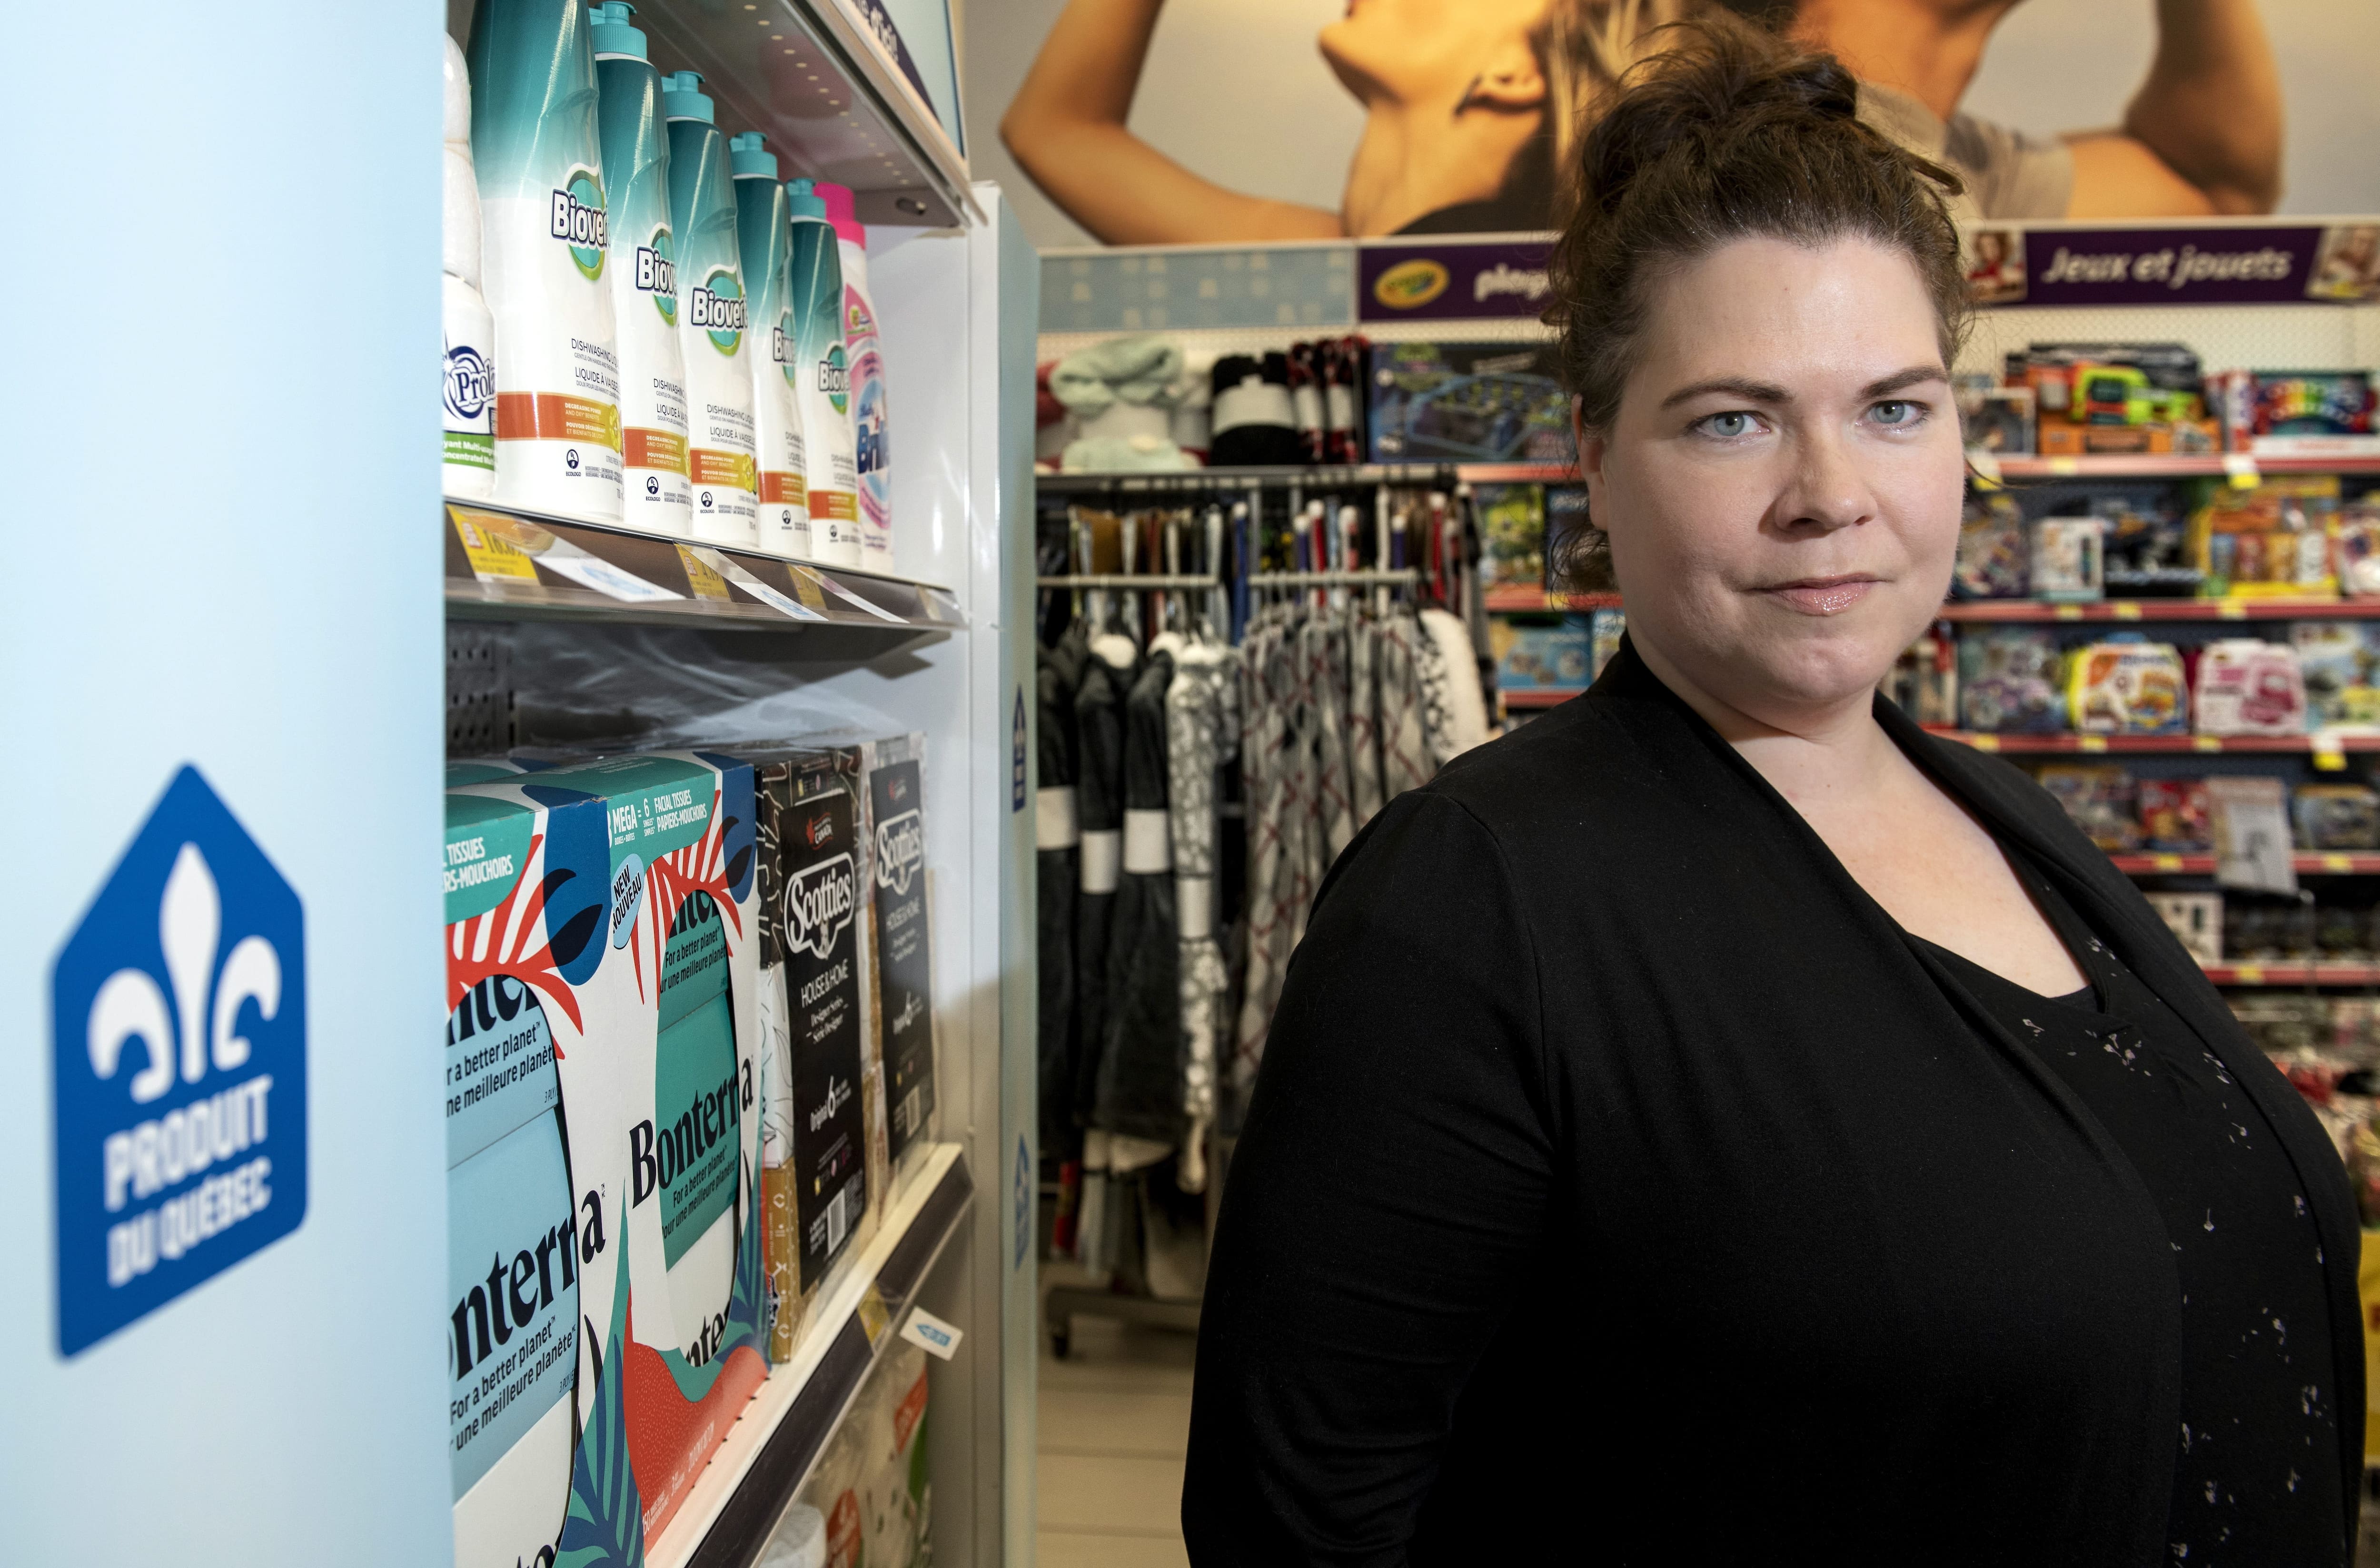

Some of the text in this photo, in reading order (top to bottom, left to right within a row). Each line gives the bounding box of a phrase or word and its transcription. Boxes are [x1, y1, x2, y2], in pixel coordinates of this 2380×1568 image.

[2042, 244, 2294, 290] Jeux et jouets
[571, 338, 611, 362] DISHWASHING
[575, 366, 600, 384] LIQUIDE
[601, 372, 605, 385] À
[565, 403, 602, 415] DEGREASING POWER
[657, 403, 677, 417] LIQUIDE
[677, 407, 680, 419] À
[573, 429, 591, 437] BIENFAITS
[646, 435, 669, 444] DEGREASING
[710, 426, 738, 439] LIQUIDE À
[654, 458, 670, 466] BIENFAITS
[613, 804, 638, 834] MEGA
[644, 798, 649, 817] 6
[654, 789, 692, 814] FACIAL TISSUES
[656, 803, 707, 832] PAPIERS-MOUCHOIRS
[446, 837, 486, 865] TISSUES
[615, 836, 624, 846] BOXES
[879, 819, 921, 882] Scotties
[614, 864, 631, 902] NEW
[613, 872, 642, 934] NOUVEAU
[789, 867, 851, 942] Scotties
[665, 950, 676, 968] For
[677, 948, 680, 962] a
[681, 938, 700, 960] better
[668, 972, 680, 989] une
[681, 956, 708, 981] meilleure
[455, 1064, 462, 1082] a
[465, 1043, 500, 1077] better
[464, 1065, 517, 1108] meilleure
[520, 1045, 553, 1081] planèt
[827, 1075, 836, 1119] 6
[103, 1073, 274, 1213] PRODUIT
[629, 1058, 753, 1209] Bonterra
[673, 1187, 684, 1208] For
[684, 1183, 688, 1196] a
[689, 1164, 707, 1190] better
[676, 1205, 687, 1228] une
[688, 1180, 714, 1215] meilleure
[106, 1155, 273, 1288] DU QUÉBEC
[447, 1190, 605, 1381] nterra
[450, 1393, 470, 1426] For
[473, 1387, 479, 1406] a
[482, 1352, 517, 1398] better
[456, 1418, 479, 1451] une
[481, 1368, 534, 1428] meilleure
